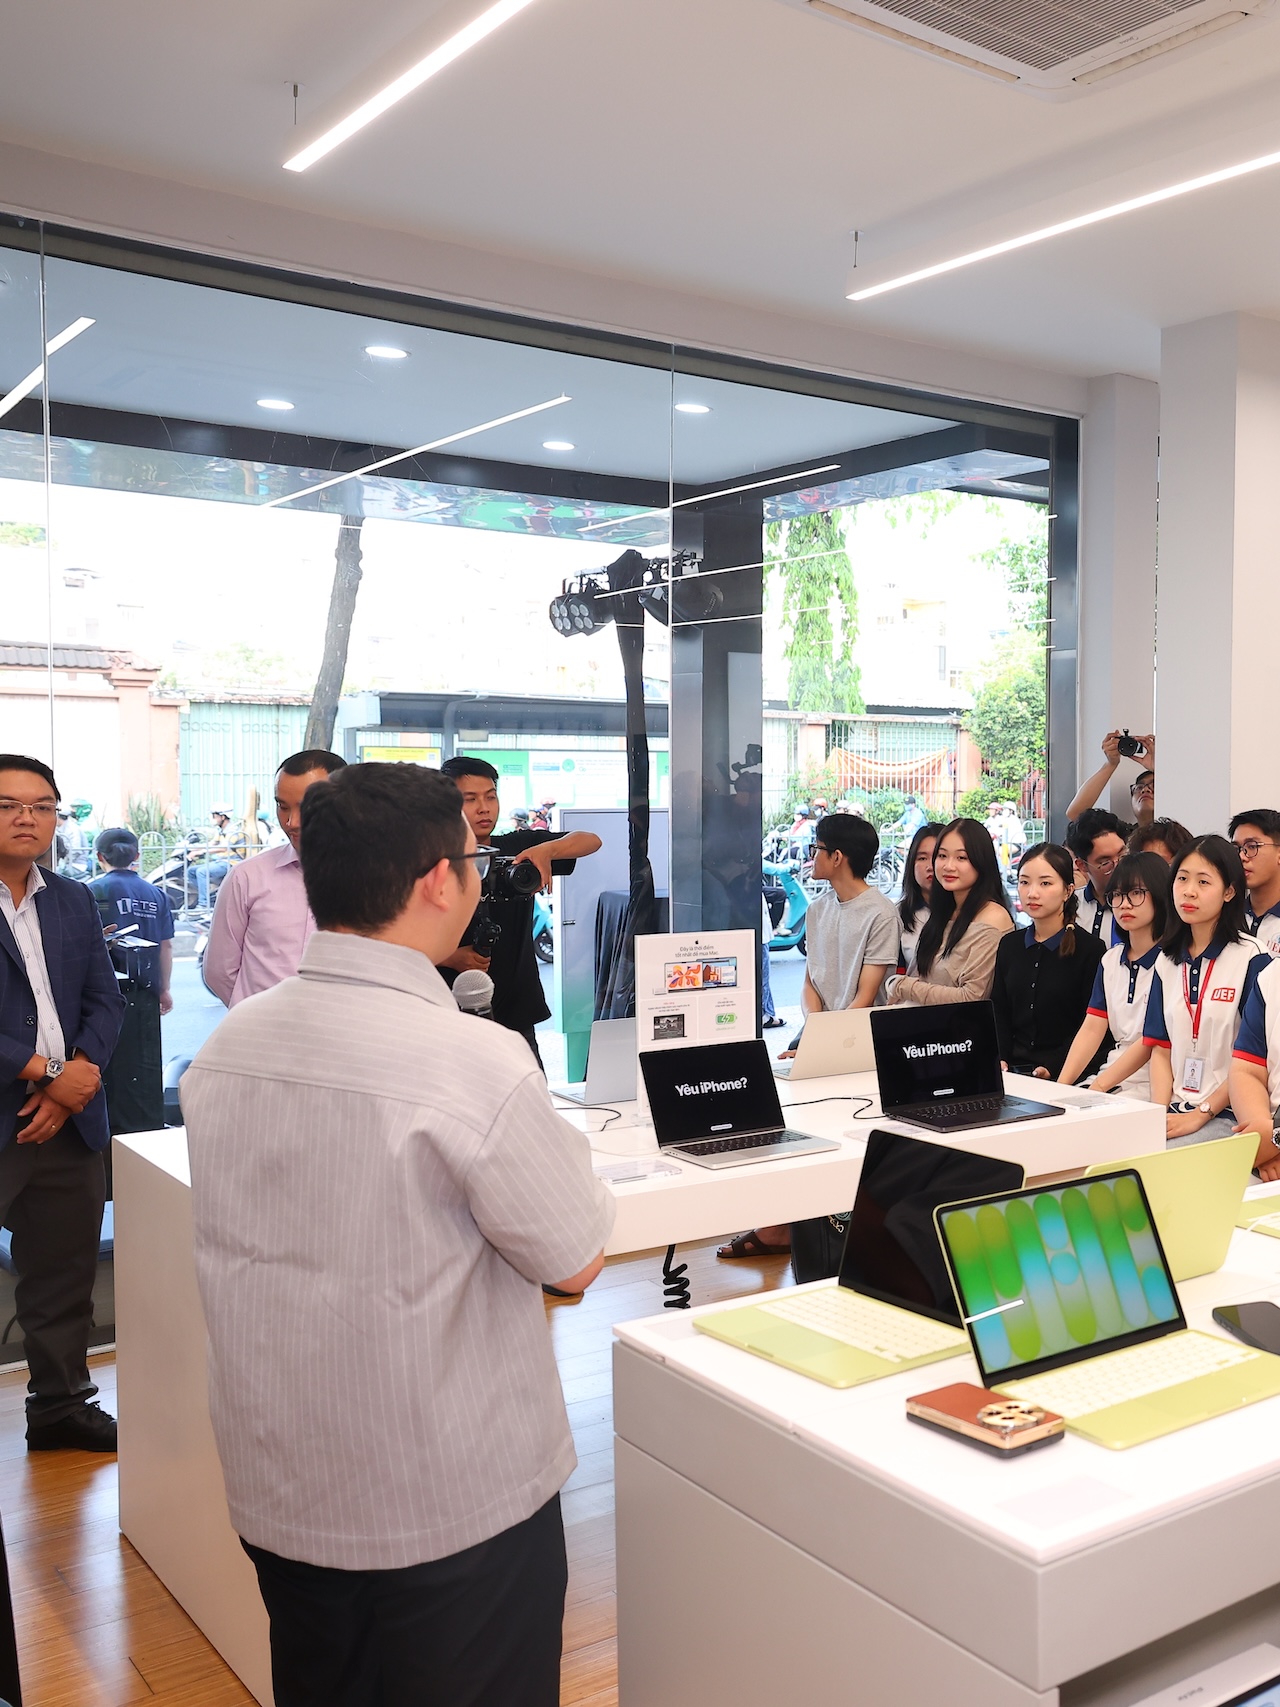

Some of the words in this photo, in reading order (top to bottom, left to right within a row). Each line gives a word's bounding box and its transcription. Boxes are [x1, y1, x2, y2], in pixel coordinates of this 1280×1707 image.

[1213, 989, 1234, 1001] UEF
[903, 1045, 926, 1059] Yêu
[926, 1040, 972, 1056] iPhone?
[675, 1083, 700, 1097] Yêu
[700, 1077, 748, 1094] iPhone?
